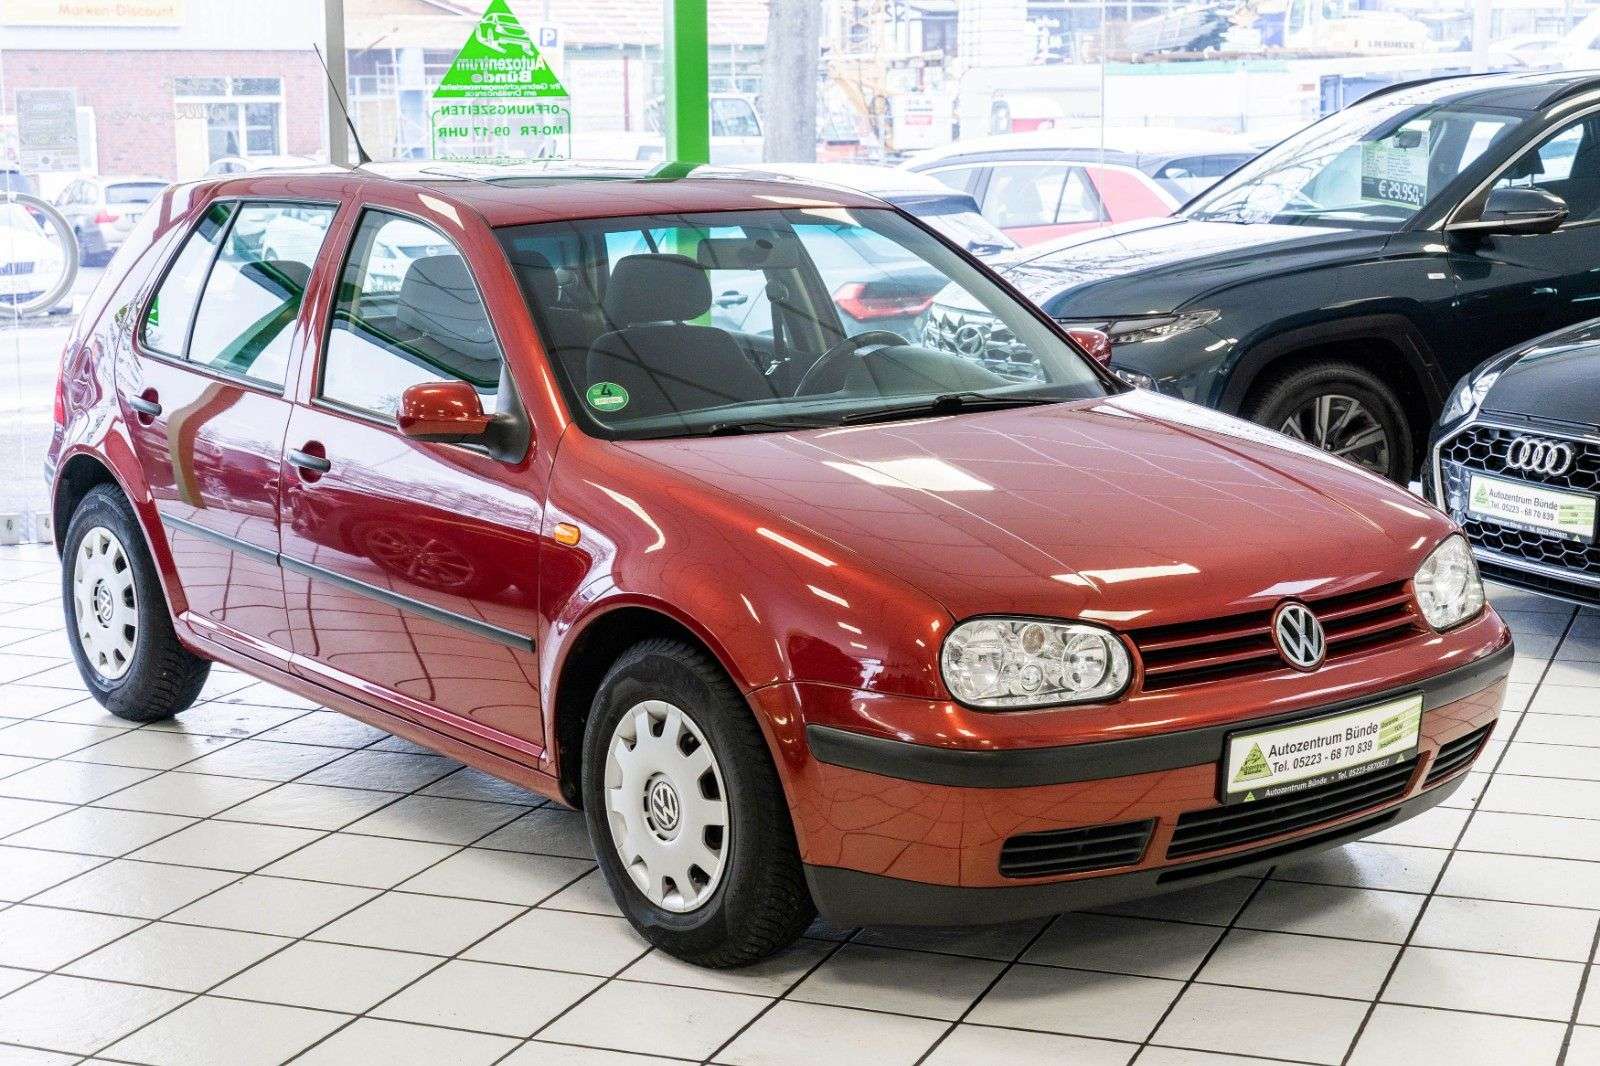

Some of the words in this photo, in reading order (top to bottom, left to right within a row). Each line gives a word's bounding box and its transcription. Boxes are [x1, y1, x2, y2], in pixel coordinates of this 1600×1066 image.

[1489, 488, 1532, 506] Autozentrum
[1268, 733, 1343, 759] Autozentrum
[1345, 722, 1378, 741] Bünde
[1272, 760, 1290, 774] Tel.
[1293, 753, 1322, 769] 05223
[1330, 748, 1341, 761] 68
[1344, 744, 1355, 757] 70
[1357, 740, 1373, 754] 839
[1264, 783, 1307, 798] Autozentrum
[1307, 776, 1328, 790] Bünde
